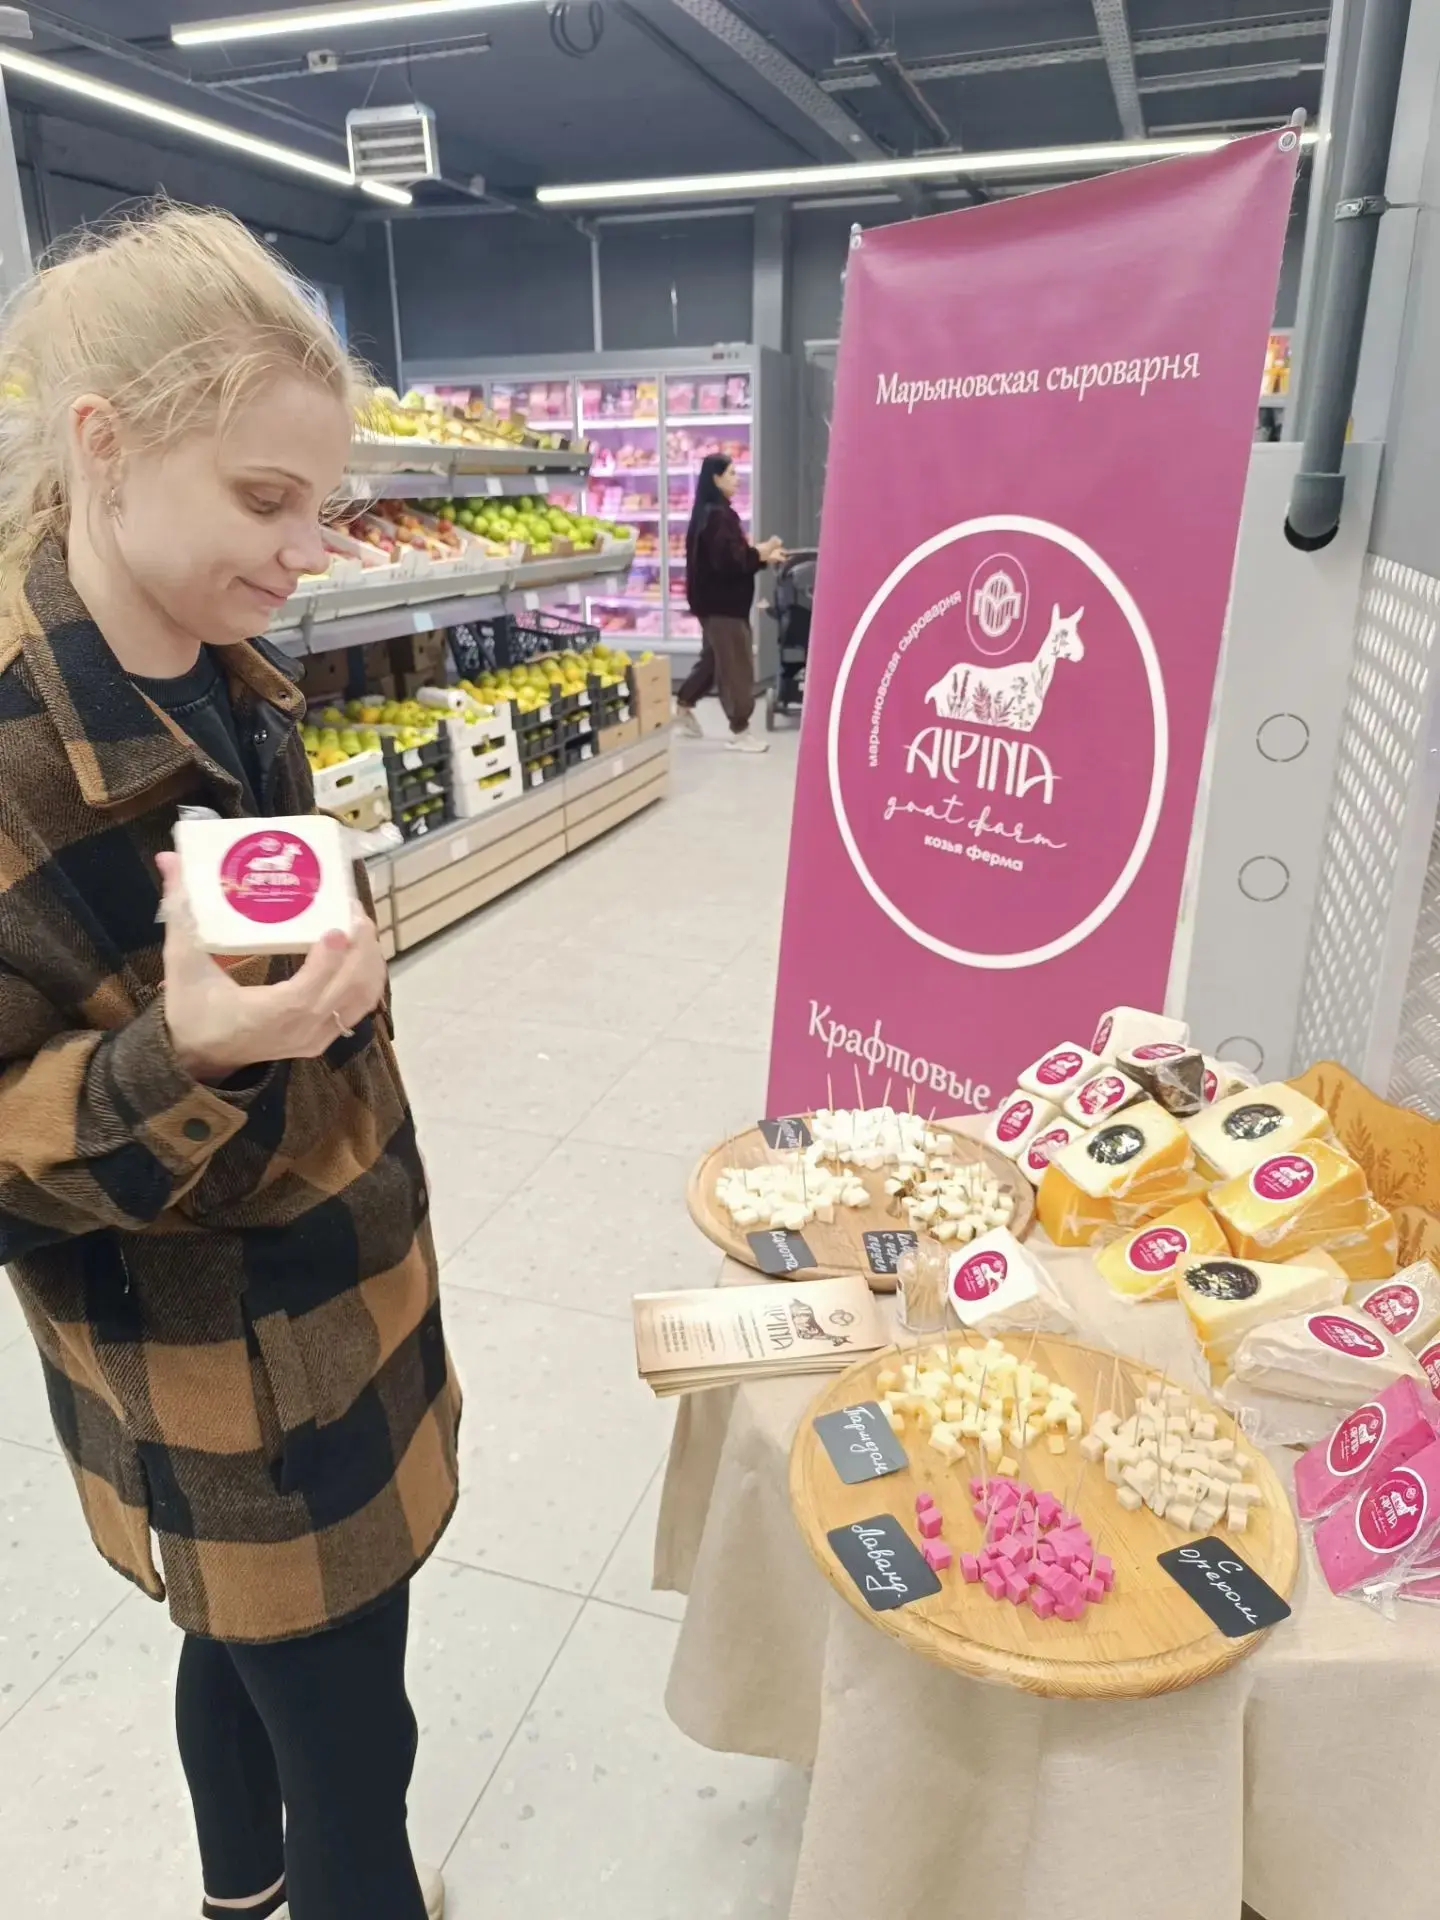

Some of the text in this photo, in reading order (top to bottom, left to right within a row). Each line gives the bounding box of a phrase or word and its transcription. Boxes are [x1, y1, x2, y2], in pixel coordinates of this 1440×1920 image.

[876, 351, 1201, 414] Марьяновская сыроварня
[868, 590, 962, 767] марьяновская сыроварня
[903, 727, 1062, 804] ALPINA
[883, 794, 965, 824] goat
[924, 834, 1024, 872] козья ферма
[808, 1000, 991, 1111] Крафтовые
[843, 1406, 889, 1477] Пармезан
